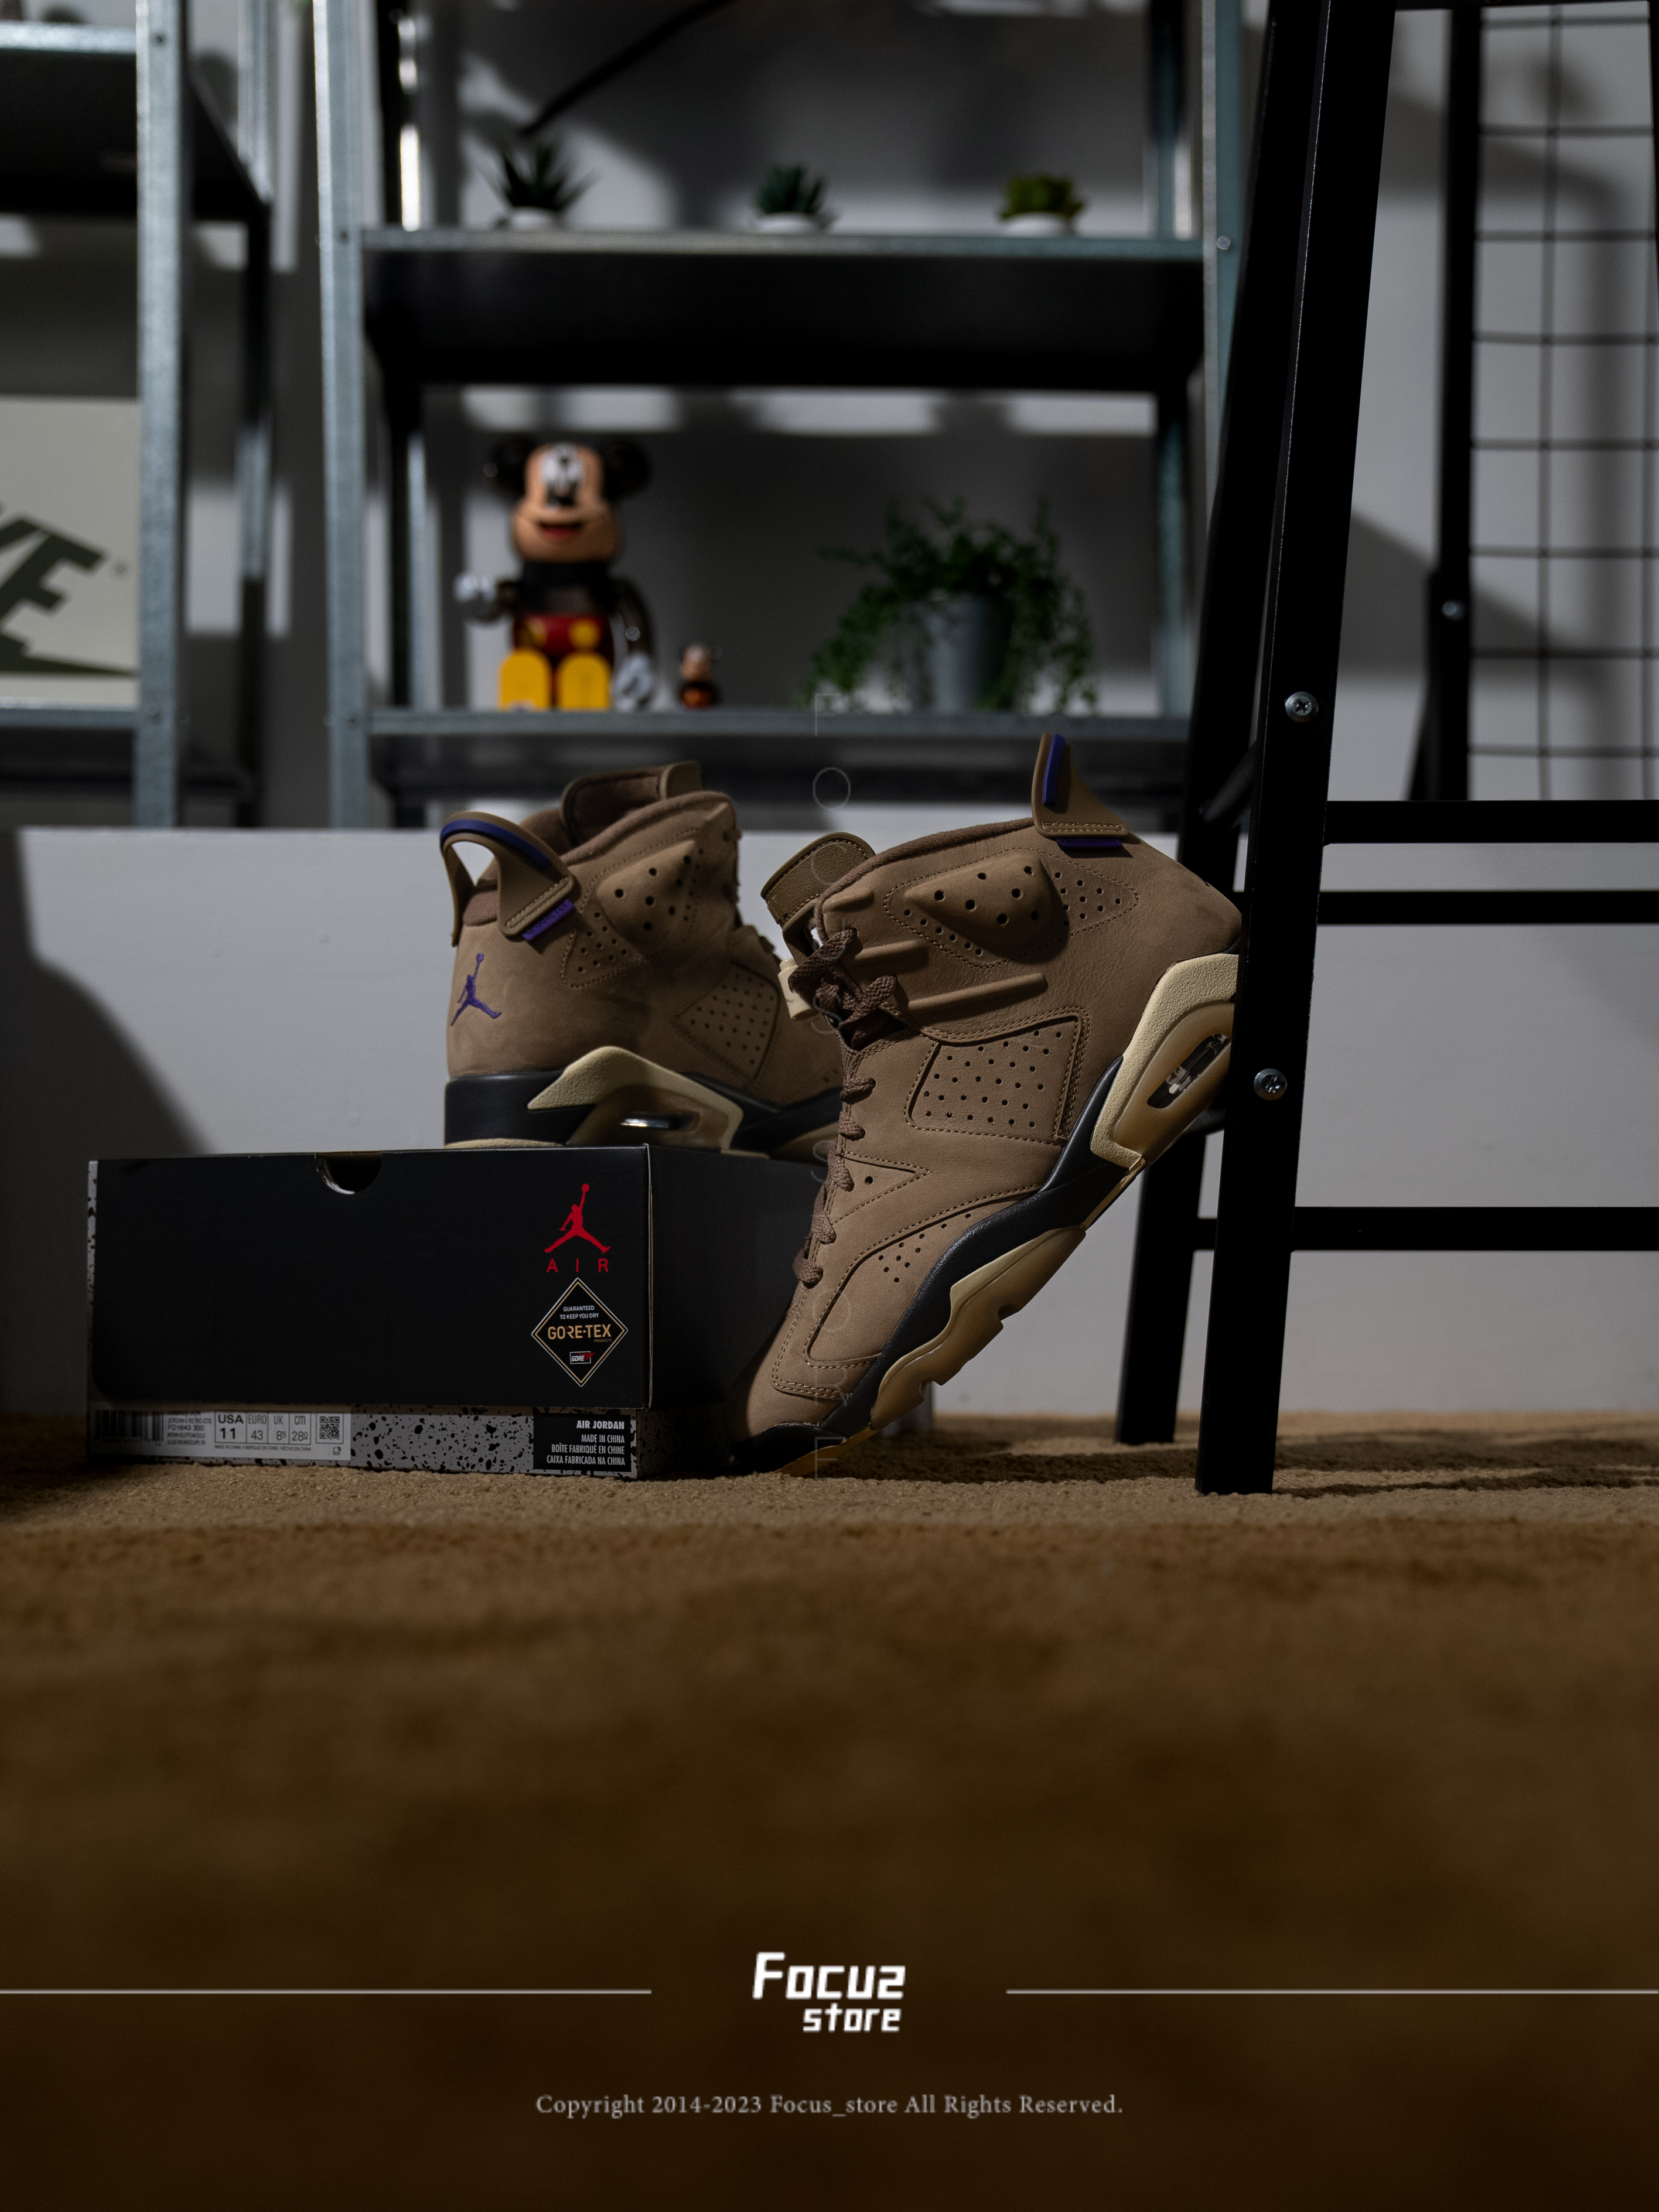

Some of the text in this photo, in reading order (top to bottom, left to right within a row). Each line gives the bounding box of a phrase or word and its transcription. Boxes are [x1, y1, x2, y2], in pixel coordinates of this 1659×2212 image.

[547, 1259, 609, 1272] AIR
[547, 1324, 612, 1340] GORE-TEX
[218, 1414, 244, 1424] USA
[248, 1415, 267, 1425] EURO
[274, 1415, 284, 1425] UK
[576, 1420, 624, 1430] AIR JORDAN
[220, 1428, 235, 1439] 11
[251, 1430, 264, 1440] 43
[581, 1433, 625, 1443] MADE IN CHINA
[598, 1445, 606, 1454] EN
[607, 1446, 625, 1455] CHINE
[547, 1455, 626, 1466] CAIXA FABRICADA NA CHINA
